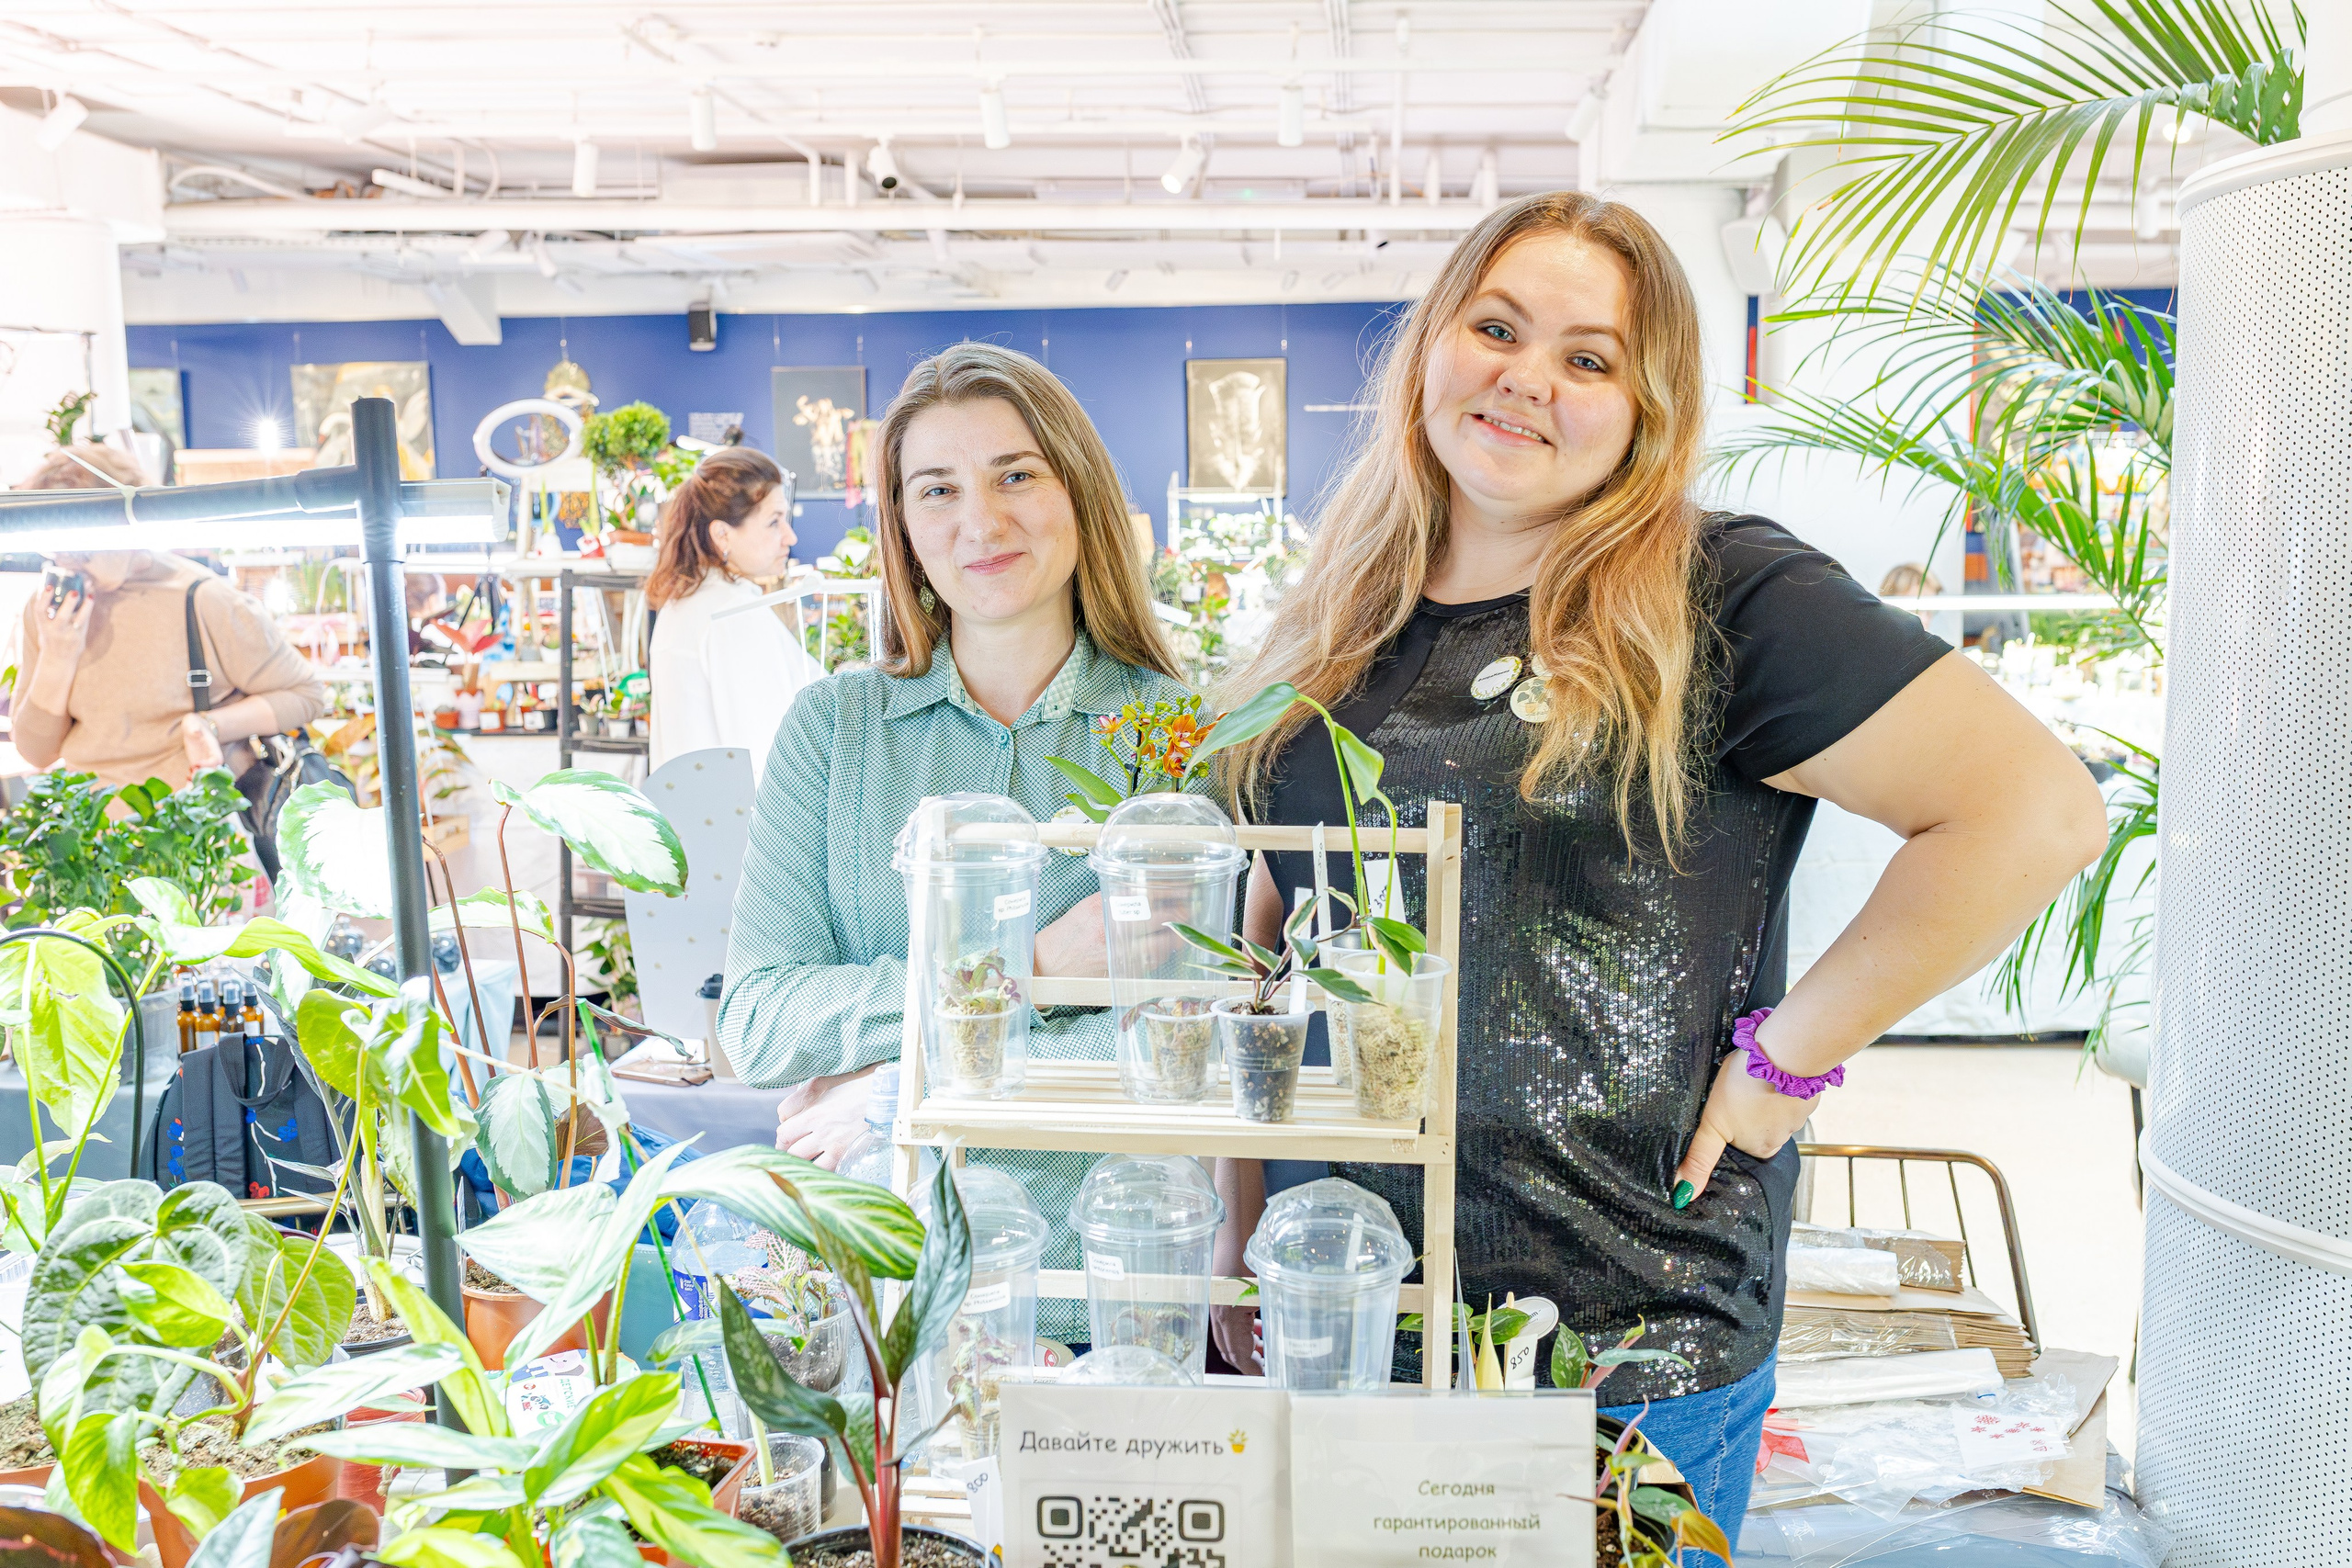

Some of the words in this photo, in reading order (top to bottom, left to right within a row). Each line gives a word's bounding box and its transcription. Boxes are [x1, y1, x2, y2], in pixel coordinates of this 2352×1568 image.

[1510, 1347, 1529, 1370] 850
[1019, 1430, 1117, 1454] Давайте
[1125, 1438, 1224, 1460] дружить
[967, 1472, 989, 1494] 800
[1418, 1480, 1496, 1497] Сегодня
[1374, 1513, 1541, 1535] гарантированный
[1419, 1545, 1498, 1562] подарок
